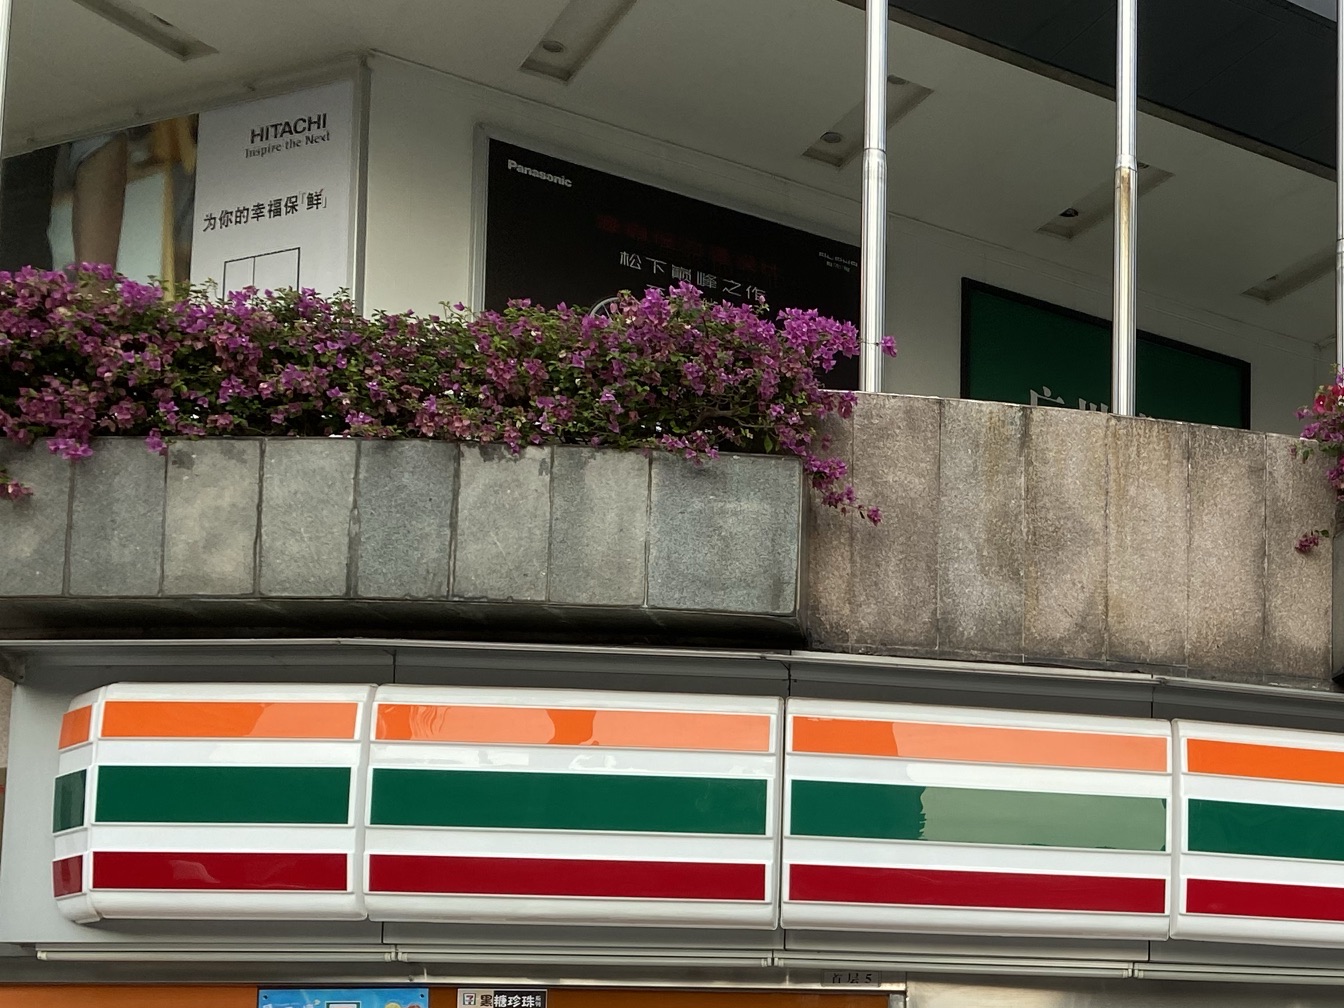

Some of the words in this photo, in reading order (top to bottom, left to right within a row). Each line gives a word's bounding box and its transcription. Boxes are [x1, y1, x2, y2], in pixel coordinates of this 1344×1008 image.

[250, 113, 327, 144] HITACHI
[245, 144, 282, 158] Inspire
[285, 138, 302, 150] the
[305, 130, 330, 145] Next
[507, 159, 573, 188] Panasonic
[480, 994, 535, 1008] 黑糖珍珠
